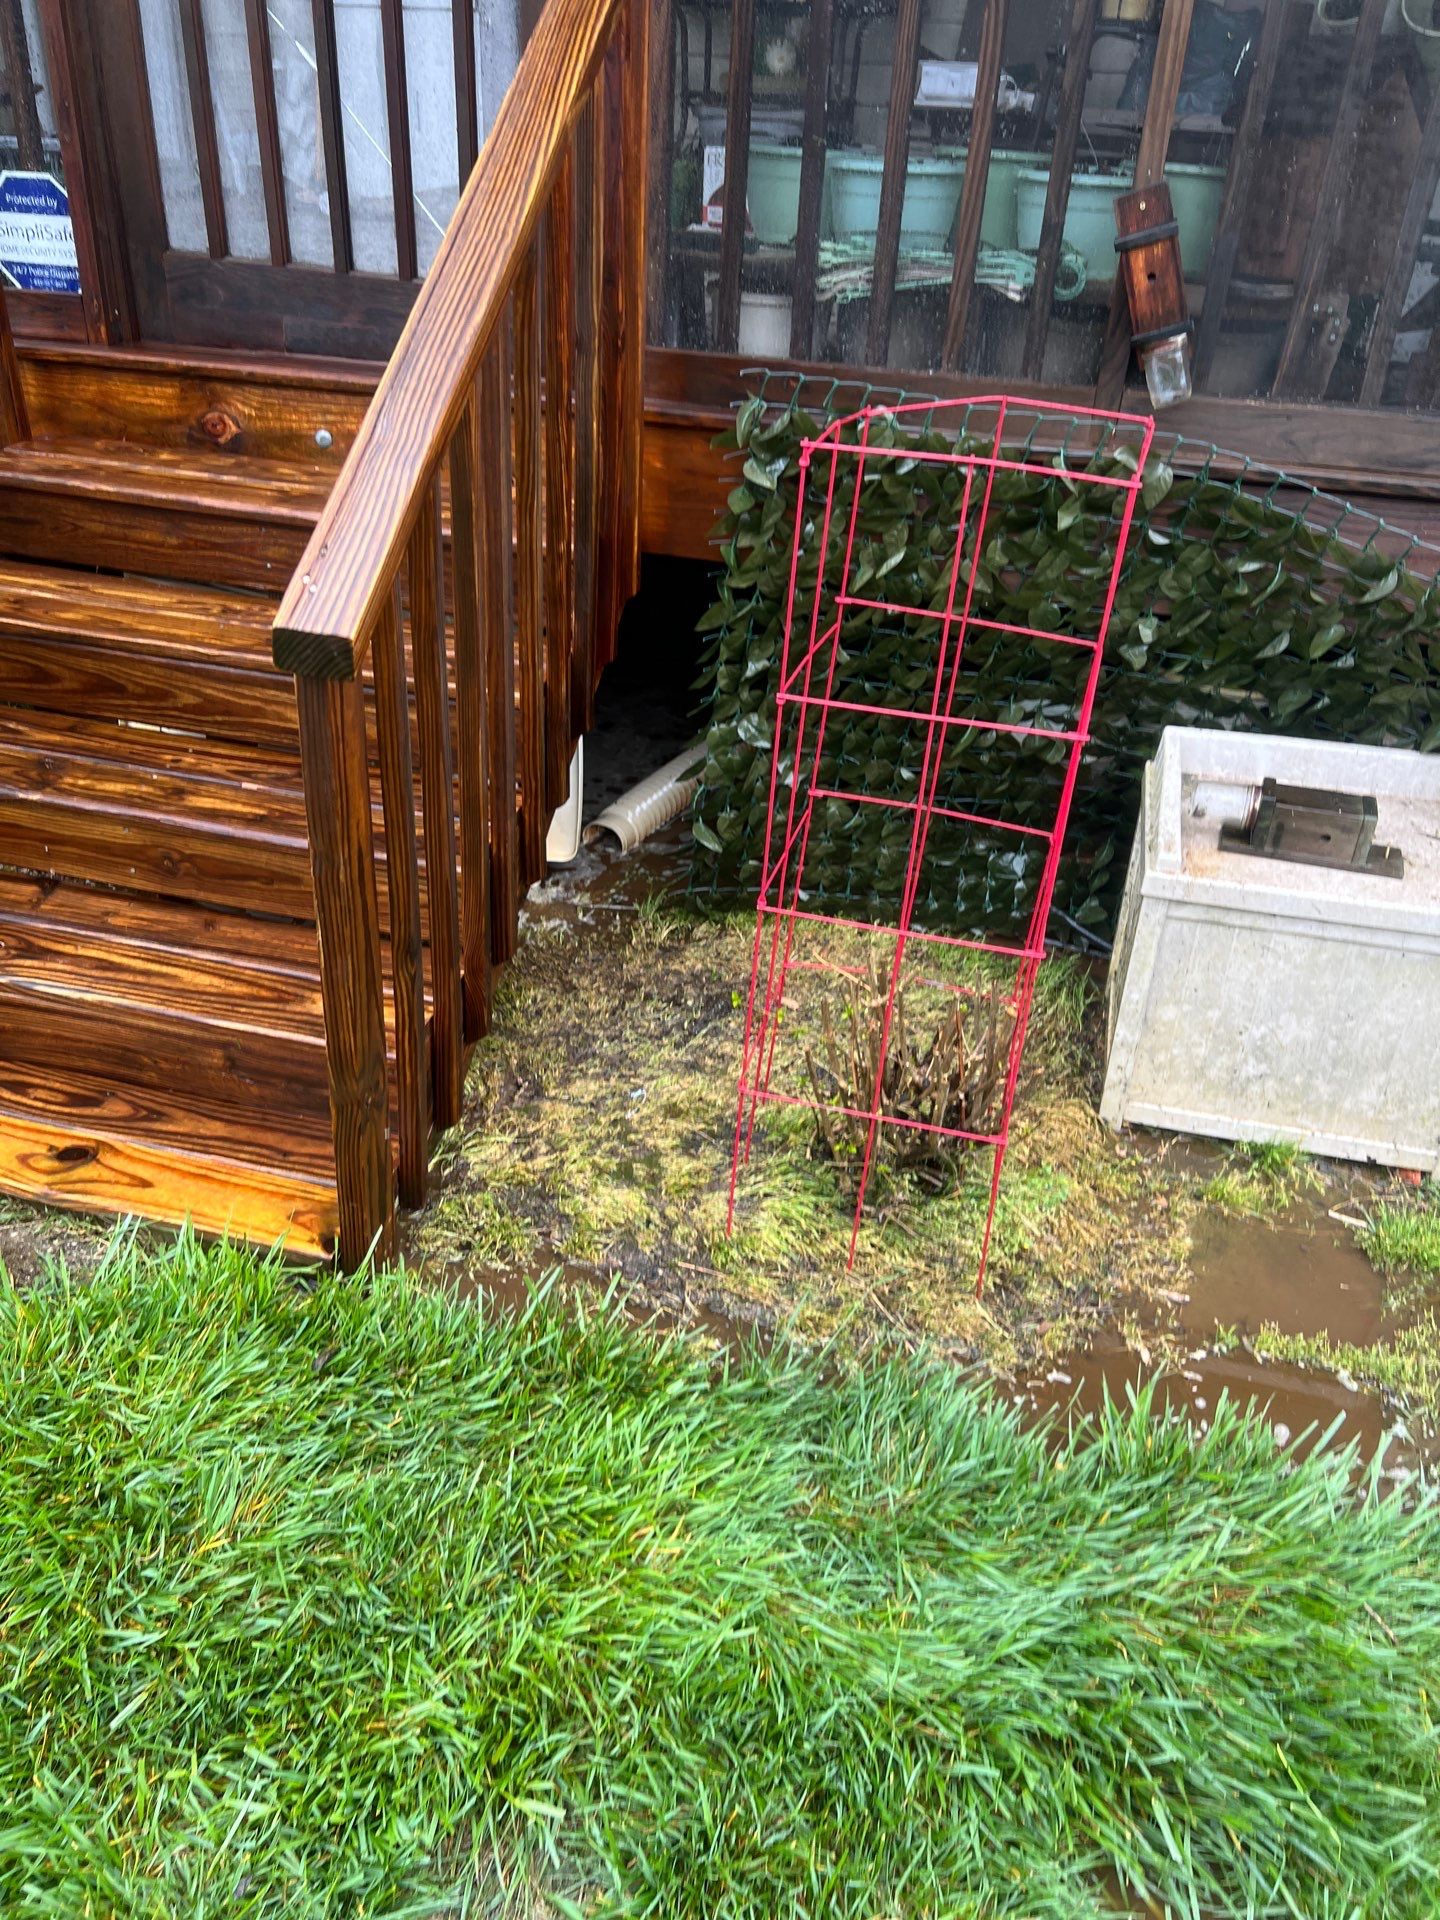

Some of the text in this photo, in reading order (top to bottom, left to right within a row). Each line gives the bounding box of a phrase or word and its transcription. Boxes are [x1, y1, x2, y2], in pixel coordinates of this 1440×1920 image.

[5, 192, 58, 210] Protected by
[28, 266, 49, 278] Police
